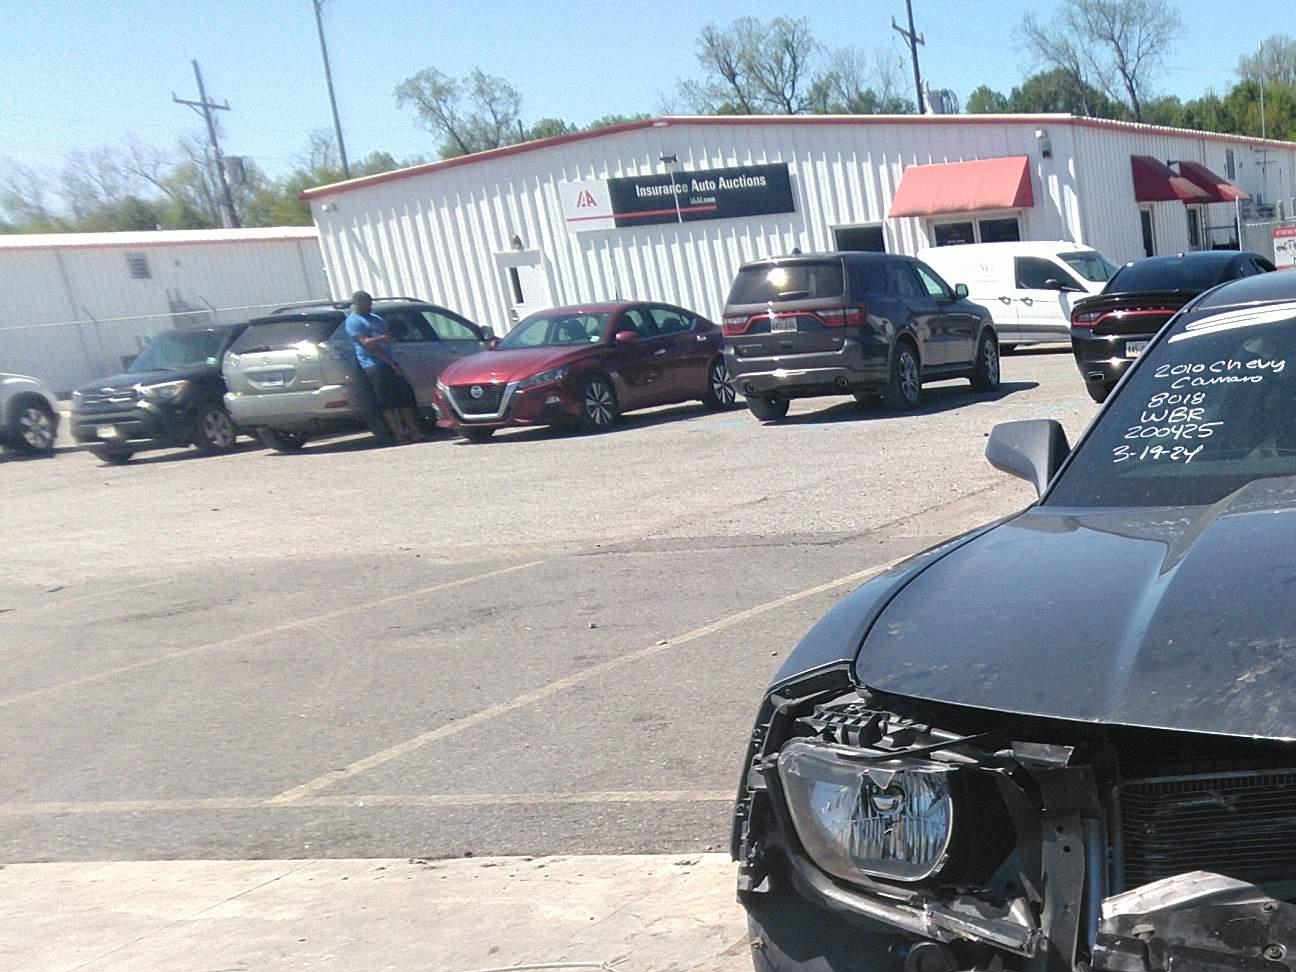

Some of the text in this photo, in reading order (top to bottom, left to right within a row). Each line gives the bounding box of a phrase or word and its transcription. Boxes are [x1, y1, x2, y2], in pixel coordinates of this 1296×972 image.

[635, 173, 767, 198] Insurance Auto Auctions
[1154, 358, 1286, 378] 2010 Chevy
[1171, 374, 1263, 389] Camaro
[1147, 392, 1206, 408] 8018
[1140, 407, 1205, 423] WBR
[1124, 421, 1225, 440] 200425
[1112, 444, 1205, 463] 3-19-24
